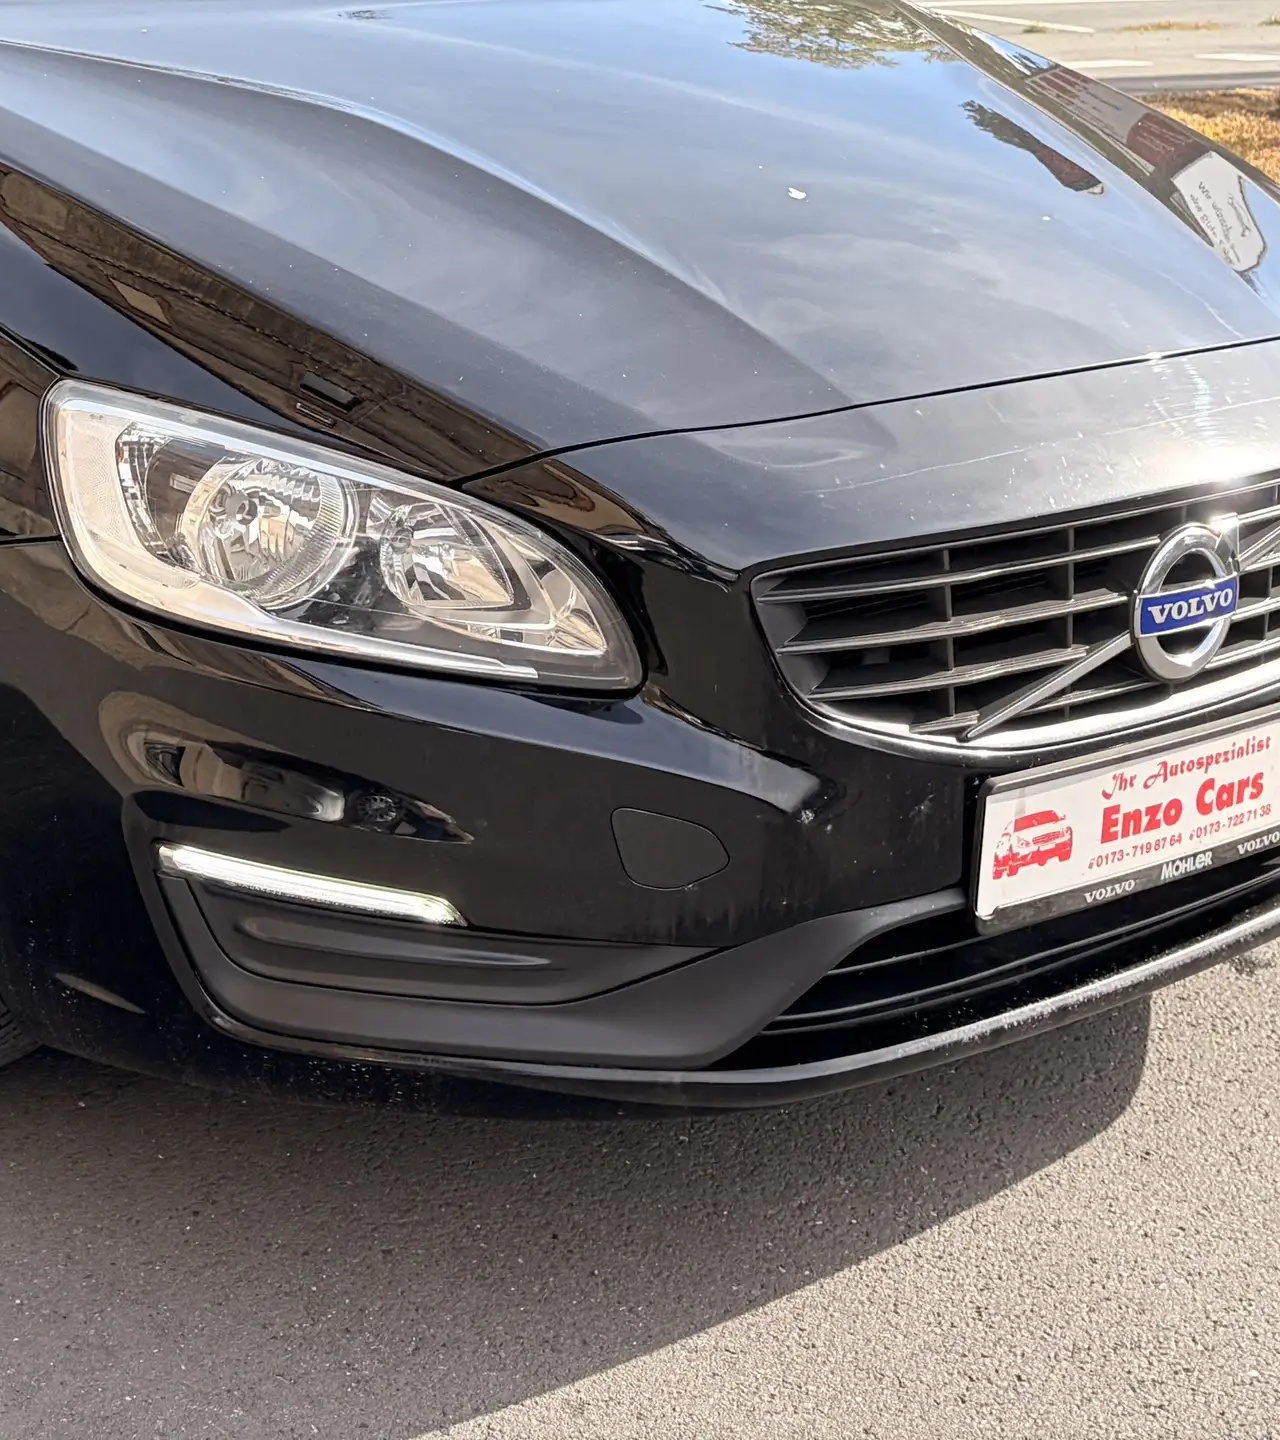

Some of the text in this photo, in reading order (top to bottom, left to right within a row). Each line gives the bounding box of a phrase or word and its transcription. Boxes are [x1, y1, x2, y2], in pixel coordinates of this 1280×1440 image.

[1147, 588, 1233, 625] VOLVO
[1102, 735, 1272, 800] Ihr Autospezialist
[1100, 772, 1264, 845] Enzo Cars
[1084, 878, 1136, 904] VOLVO
[1236, 831, 1280, 855] VOLVO
